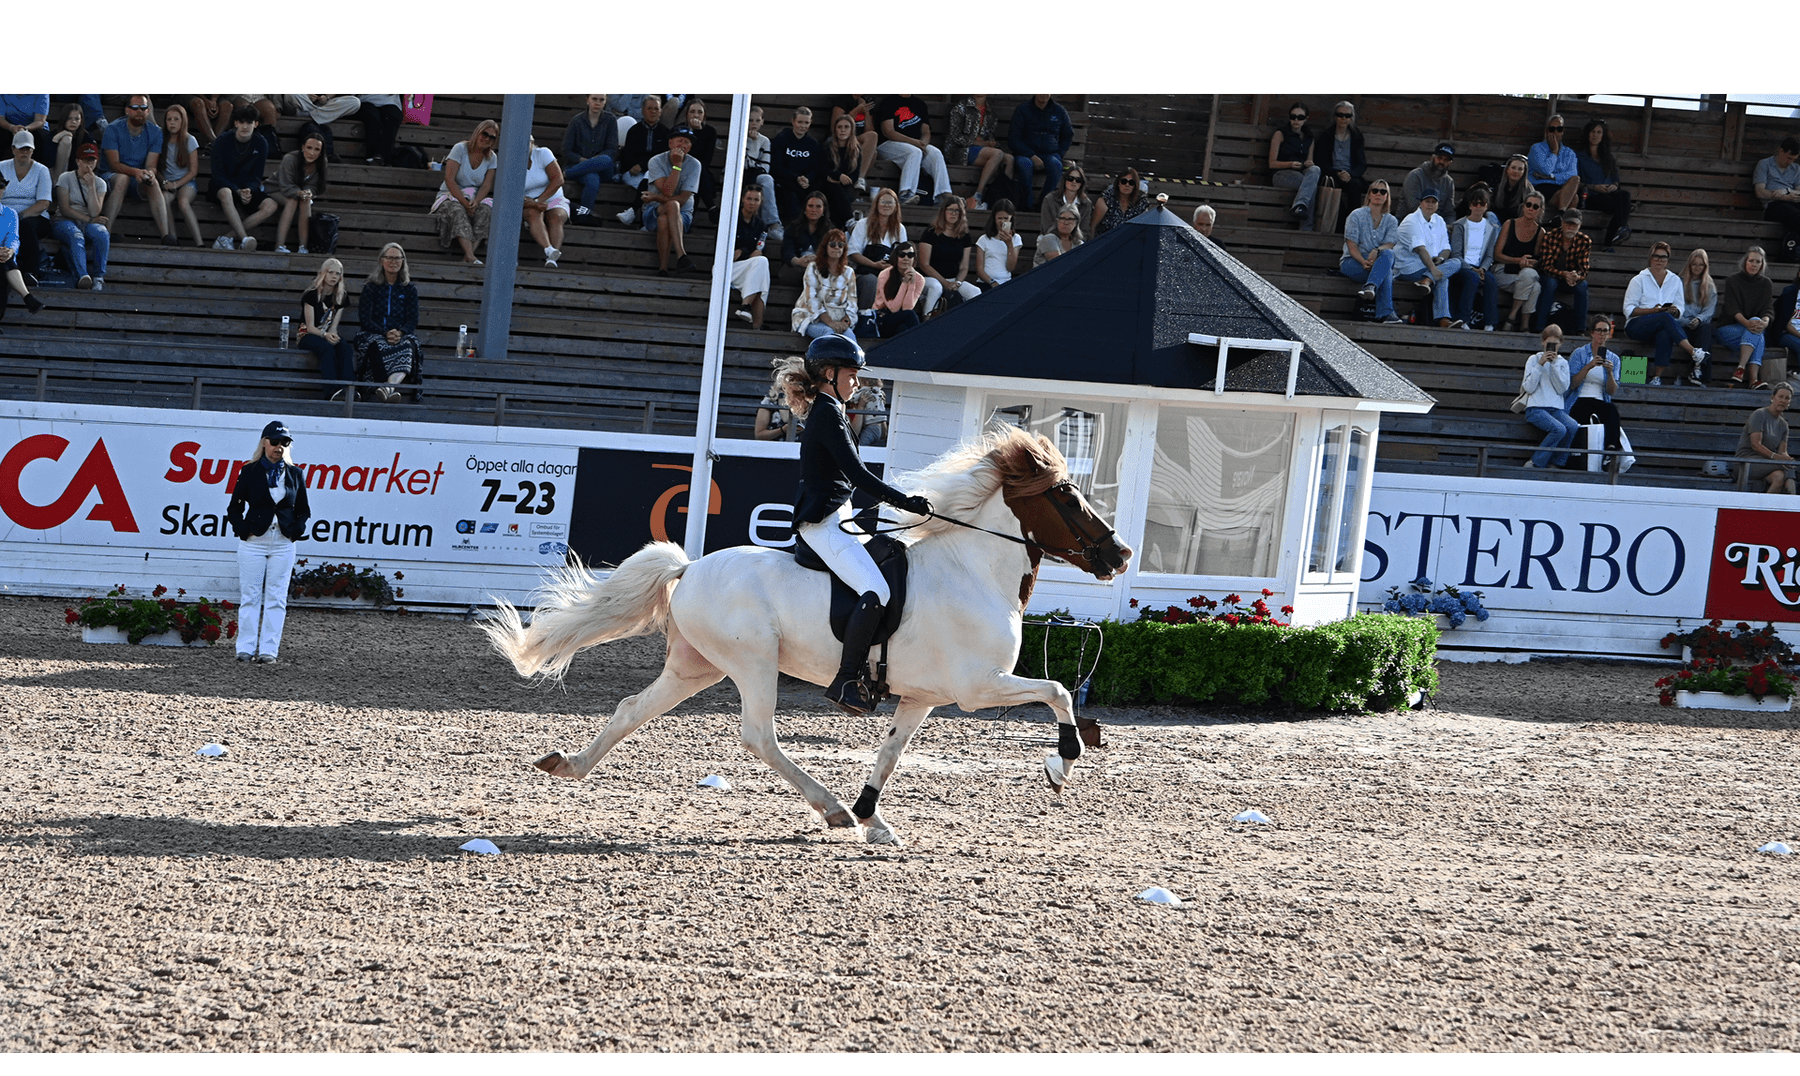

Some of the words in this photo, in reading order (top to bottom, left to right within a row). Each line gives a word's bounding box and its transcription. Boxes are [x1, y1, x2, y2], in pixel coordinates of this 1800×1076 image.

[164, 440, 445, 496] Supmarket
[465, 454, 509, 474] Öppet
[510, 459, 534, 473] alla
[536, 460, 578, 478] dagar
[1724, 541, 1800, 606] Ri
